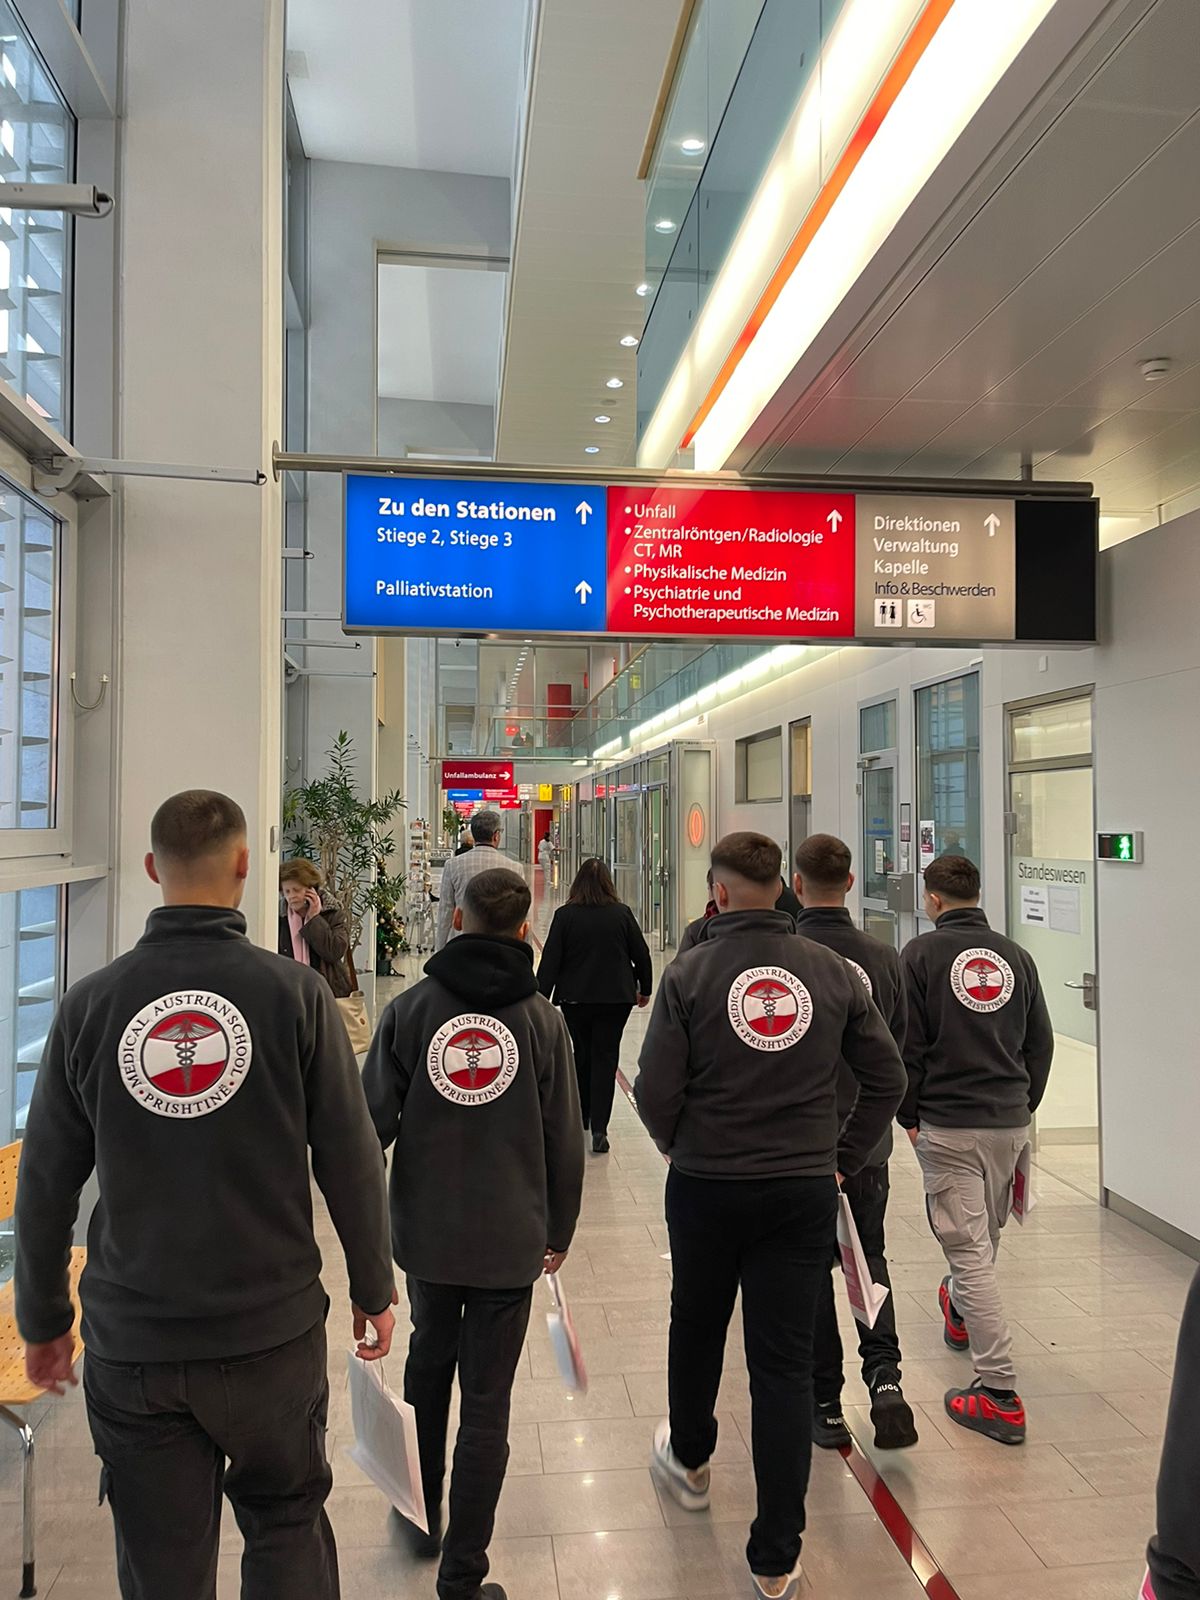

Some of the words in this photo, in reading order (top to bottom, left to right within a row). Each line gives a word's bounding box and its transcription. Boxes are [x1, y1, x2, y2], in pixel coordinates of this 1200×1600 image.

[378, 498, 404, 515] Zu
[411, 498, 450, 517] den
[456, 501, 556, 521] Stationen
[634, 504, 676, 518] Unfall
[874, 516, 960, 532] Direktionen
[377, 527, 426, 547] Stiege
[431, 530, 445, 547] 2,
[450, 530, 498, 549] Stiege
[503, 532, 513, 547] 3
[633, 525, 824, 546] Zentralröntgen/Radiologie
[633, 543, 656, 559] CT,
[659, 544, 682, 558] MR
[873, 538, 959, 557] Verwaltung
[634, 564, 727, 582] Physikalische
[731, 566, 787, 581] Medizin
[874, 559, 929, 577] Kapelle
[376, 580, 493, 598] Palliativstation
[634, 585, 710, 603] Psychiatrie
[714, 587, 742, 601] und
[633, 604, 782, 622] Psychotherapeutische
[786, 607, 839, 621] Medizin
[1018, 862, 1086, 884] Standeswesen
[731, 981, 744, 1028] MEDICAL
[745, 969, 796, 985] AUSTRIAN
[794, 984, 810, 1025] SCHOOL
[123, 1018, 150, 1089] MEDICAL
[153, 994, 231, 1017] AUSTRIAN
[227, 1015, 247, 1078] SCHOOL
[431, 1031, 449, 1082] MEDICAL
[451, 1016, 505, 1034] AUSTRIAN
[502, 1034, 516, 1079] SCHOOL
